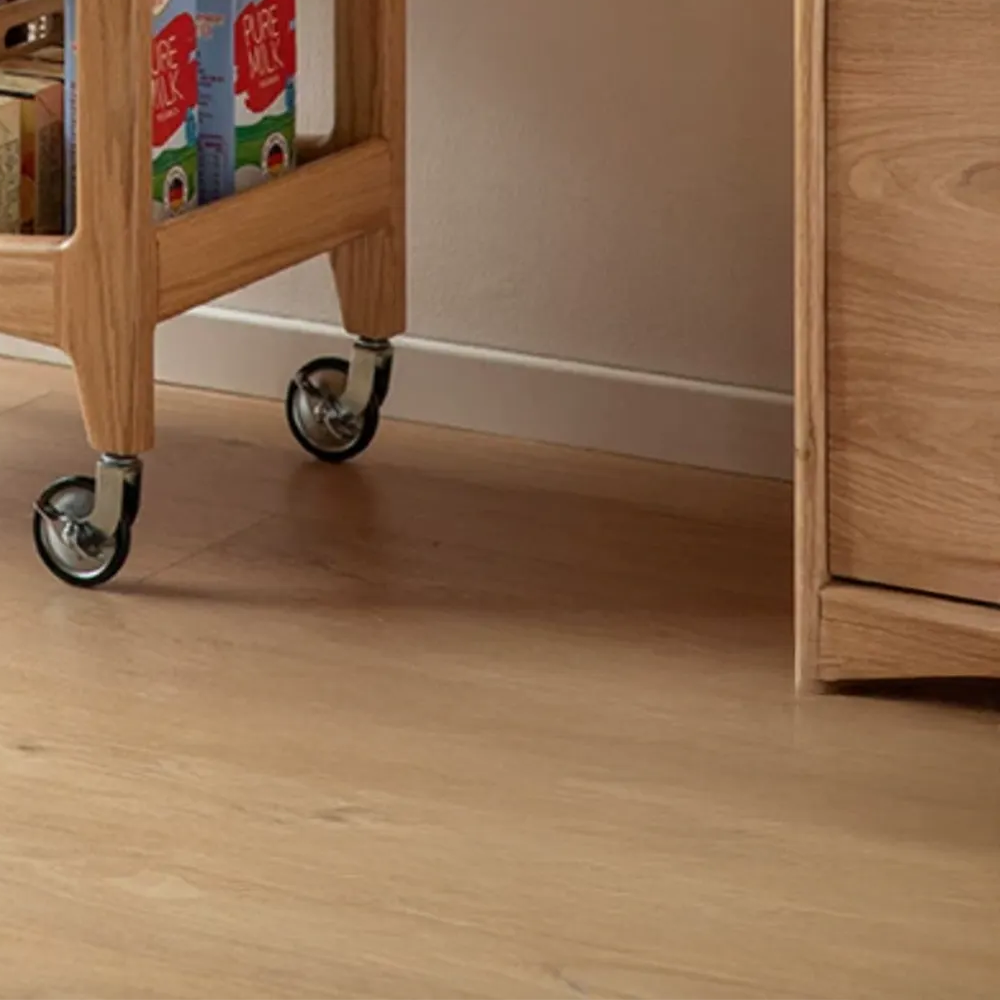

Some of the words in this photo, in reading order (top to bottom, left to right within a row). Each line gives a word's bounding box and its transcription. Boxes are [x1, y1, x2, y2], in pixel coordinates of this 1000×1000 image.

[242, 3, 279, 47] PURE
[151, 35, 178, 76] URE
[248, 37, 285, 80] MILK
